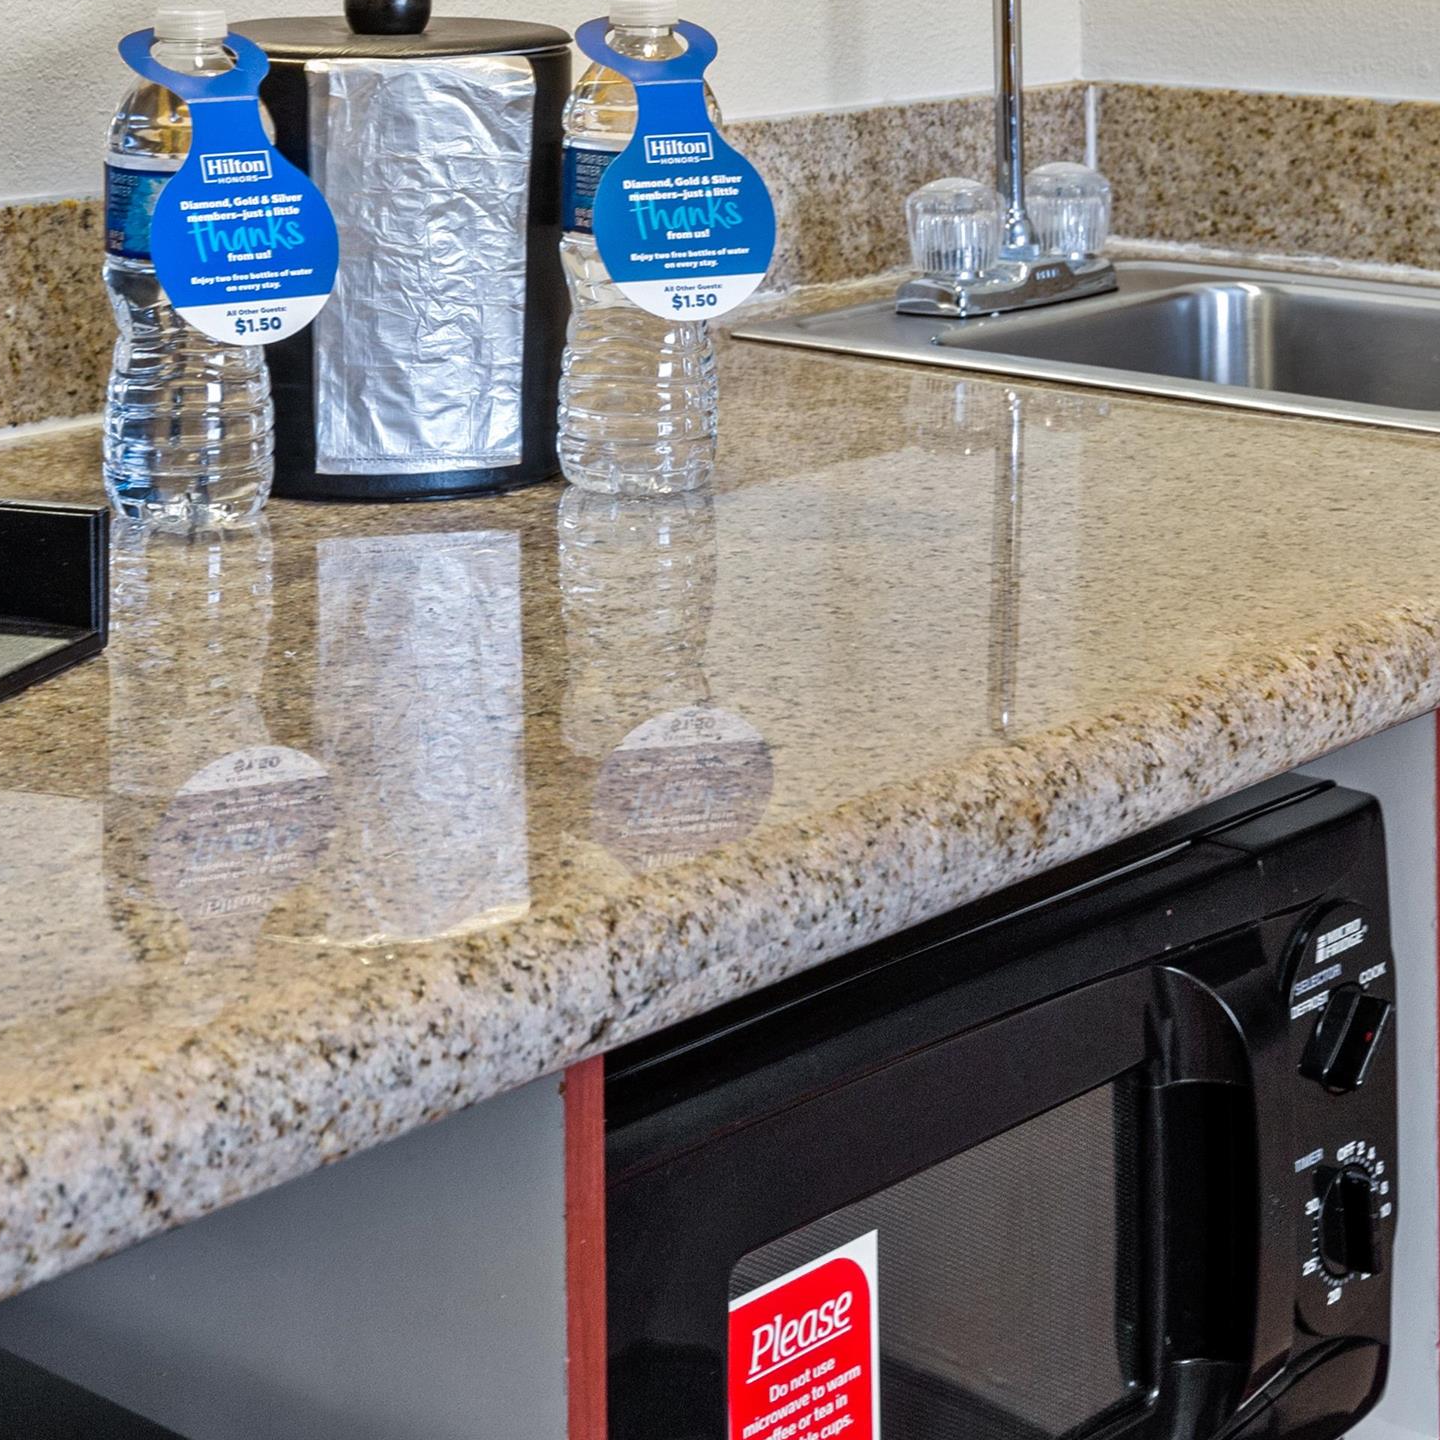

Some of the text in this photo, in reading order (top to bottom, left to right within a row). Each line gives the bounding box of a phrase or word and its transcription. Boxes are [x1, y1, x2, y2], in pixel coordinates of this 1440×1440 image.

[650, 138, 707, 157] Hilton
[207, 158, 265, 176] Hilton
[660, 156, 700, 165] HONORS
[218, 174, 259, 184] HONORS
[622, 174, 742, 190] Diamond, Gold & Silver
[713, 186, 739, 196] little
[180, 194, 303, 210] Diamond, Gold & Silver
[274, 206, 300, 216] little
[666, 229, 710, 240] from us!
[227, 250, 271, 262] from us!
[630, 253, 654, 262] Enjoy
[671, 250, 687, 258] free
[688, 248, 716, 258] bottles
[717, 247, 726, 256] of
[727, 247, 750, 255] water
[676, 260, 698, 269] every
[699, 259, 719, 267] stay.
[191, 268, 313, 286] Enjoy two free bottles of water
[238, 284, 260, 292] every
[261, 281, 281, 290] stay.
[664, 285, 674, 293] All
[676, 284, 696, 292] Other
[672, 293, 717, 311] $1.50
[239, 308, 259, 317] Other
[235, 316, 281, 335] $1.50
[1295, 963, 1342, 996] SELECTOR
[1359, 961, 1387, 985] COOK
[1290, 989, 1330, 1020] DEFROST
[1336, 1140, 1376, 1162] OFF 2 4
[1295, 1148, 1324, 1173] TIMER
[1305, 1197, 1320, 1216] 30
[1380, 1202, 1392, 1219] 10
[1302, 1256, 1321, 1277] 25
[1327, 1287, 1342, 1306] 20
[748, 1291, 853, 1376] Please
[769, 1358, 836, 1403] Do not use
[742, 1365, 862, 1440] microwave to warm
[798, 1414, 813, 1430] or
[813, 1402, 834, 1421] tea
[835, 1394, 848, 1410] in
[821, 1414, 854, 1439] cups.
